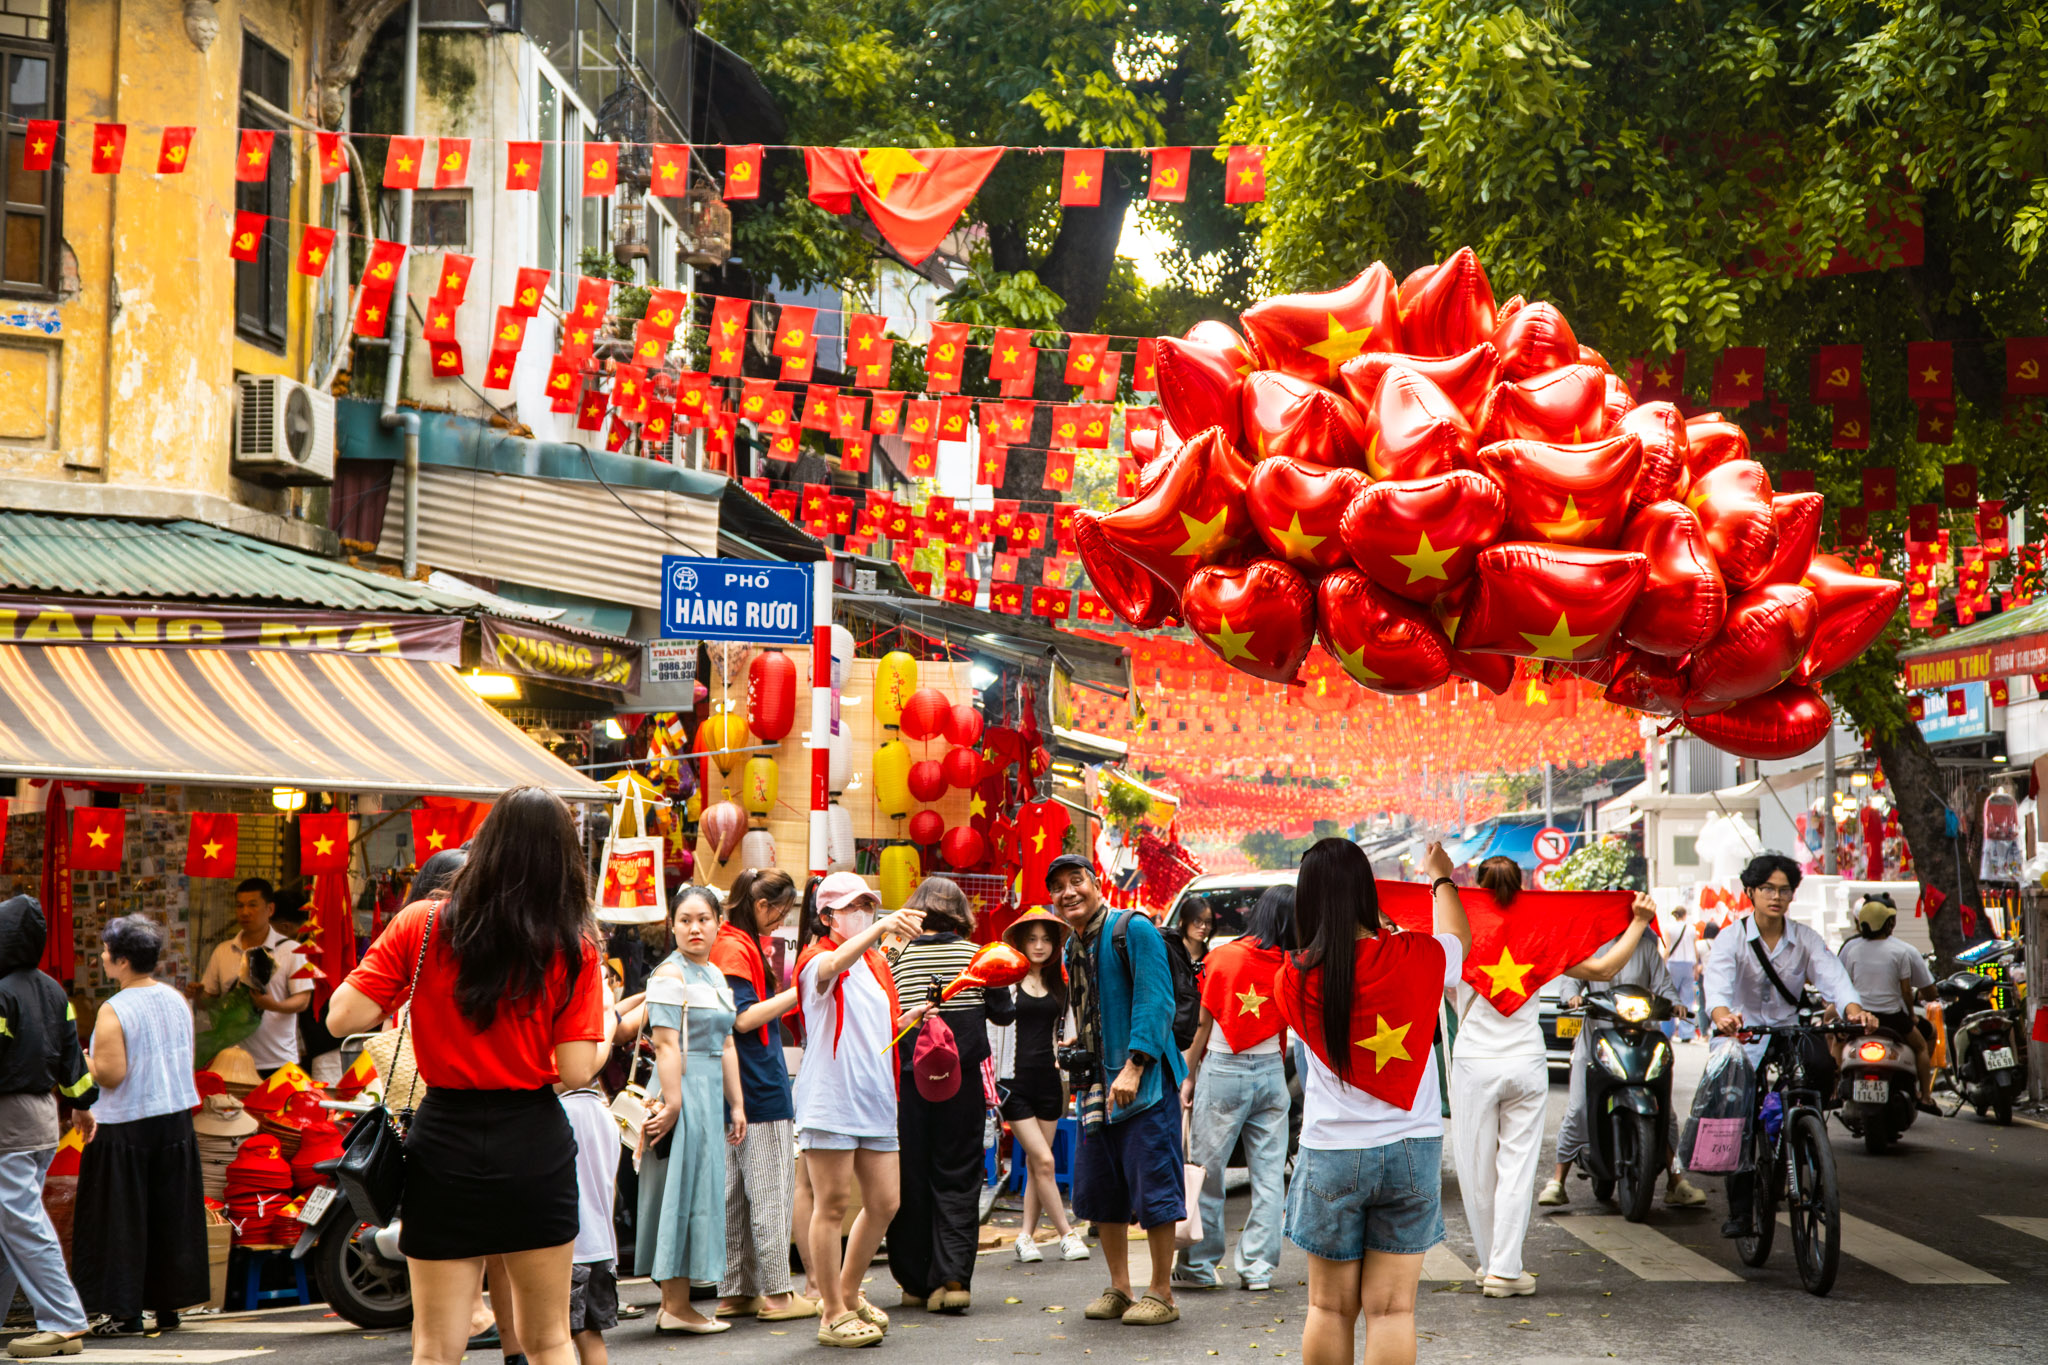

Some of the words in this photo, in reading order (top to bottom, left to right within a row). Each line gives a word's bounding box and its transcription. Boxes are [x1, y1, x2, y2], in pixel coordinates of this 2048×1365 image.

[724, 569, 771, 589] PHỐ
[675, 591, 738, 627] HÀNG
[746, 600, 798, 630] RƯƠI
[652, 647, 687, 657] THÀNH
[1910, 659, 1956, 685] THANH
[1960, 648, 1992, 679] THƯ
